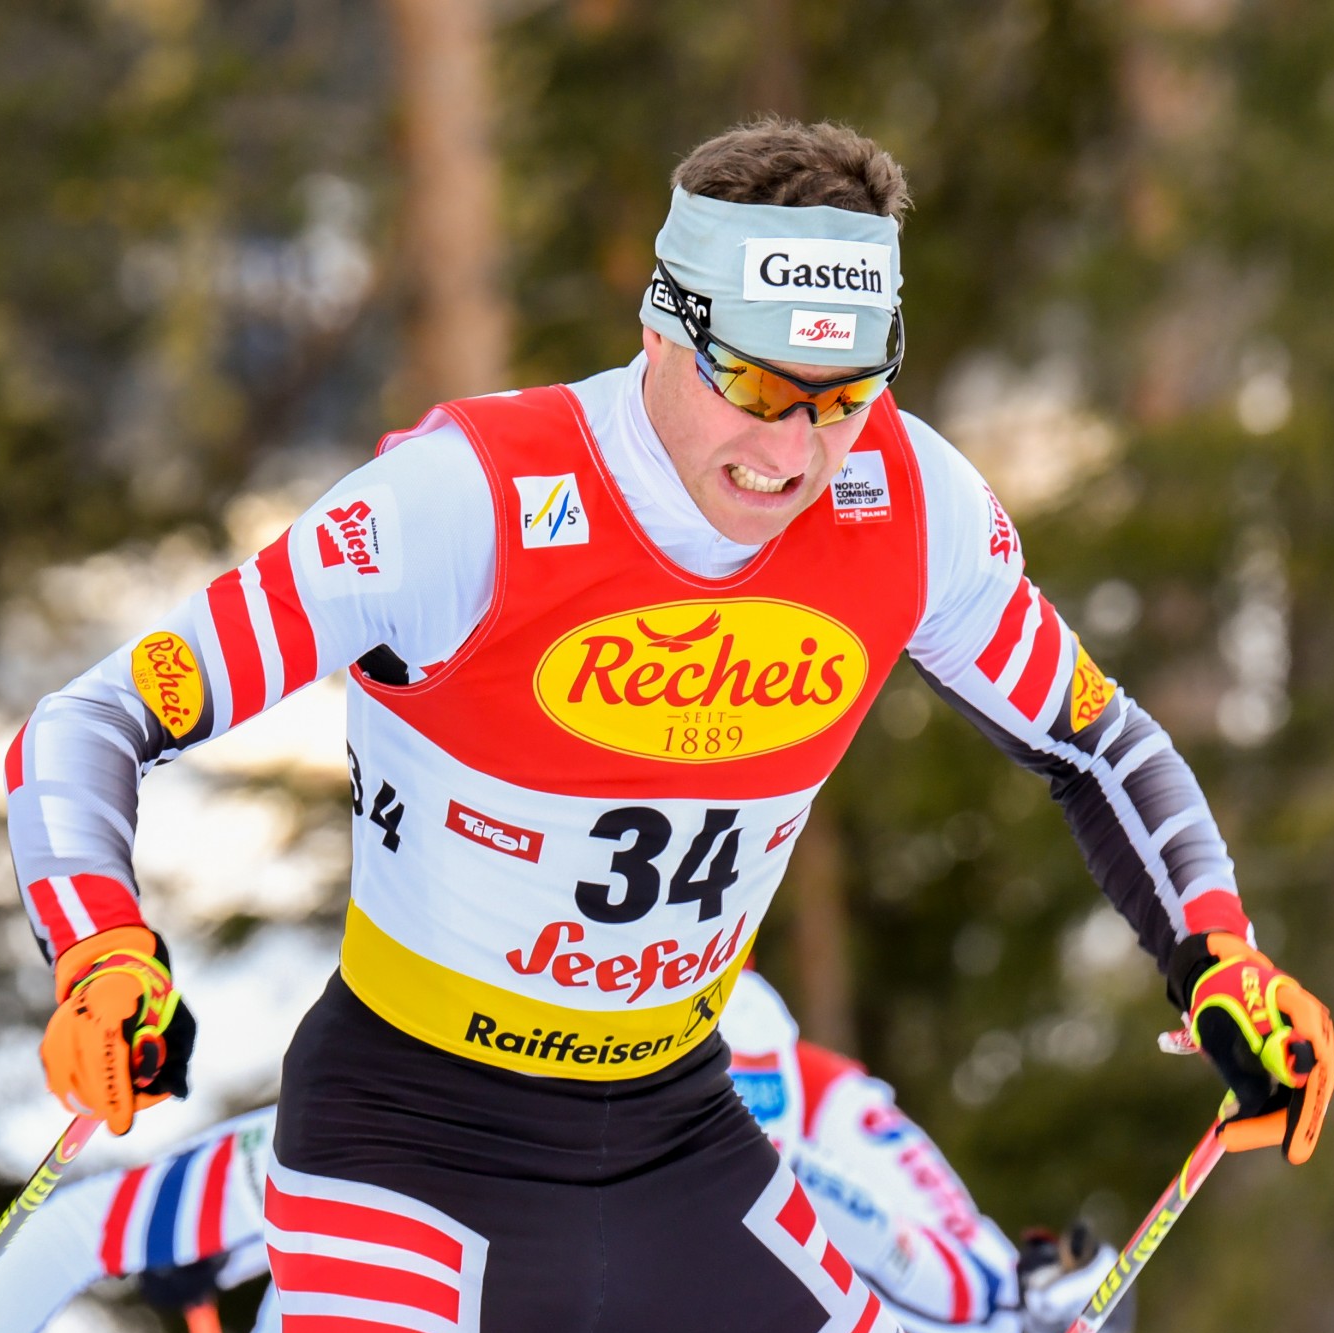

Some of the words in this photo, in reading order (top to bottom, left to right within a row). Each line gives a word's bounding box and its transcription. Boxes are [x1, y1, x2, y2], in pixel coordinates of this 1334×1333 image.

[759, 252, 882, 294] Gastein
[796, 320, 851, 341] AUSTRIA
[834, 481, 870, 491] NORDIC
[836, 488, 884, 499] COMBINED
[837, 497, 862, 505] WORLD
[524, 510, 577, 529] FIS
[839, 509, 887, 522] VIESSMANN
[326, 500, 380, 575] Stiegl
[567, 633, 844, 708] Recheis
[682, 711, 726, 723] SEIT
[662, 724, 743, 754] 1889
[458, 811, 531, 852] Tirol
[574, 806, 741, 925] 34
[506, 911, 748, 1005] Seefeld
[465, 1011, 673, 1065] Raiffeisen
